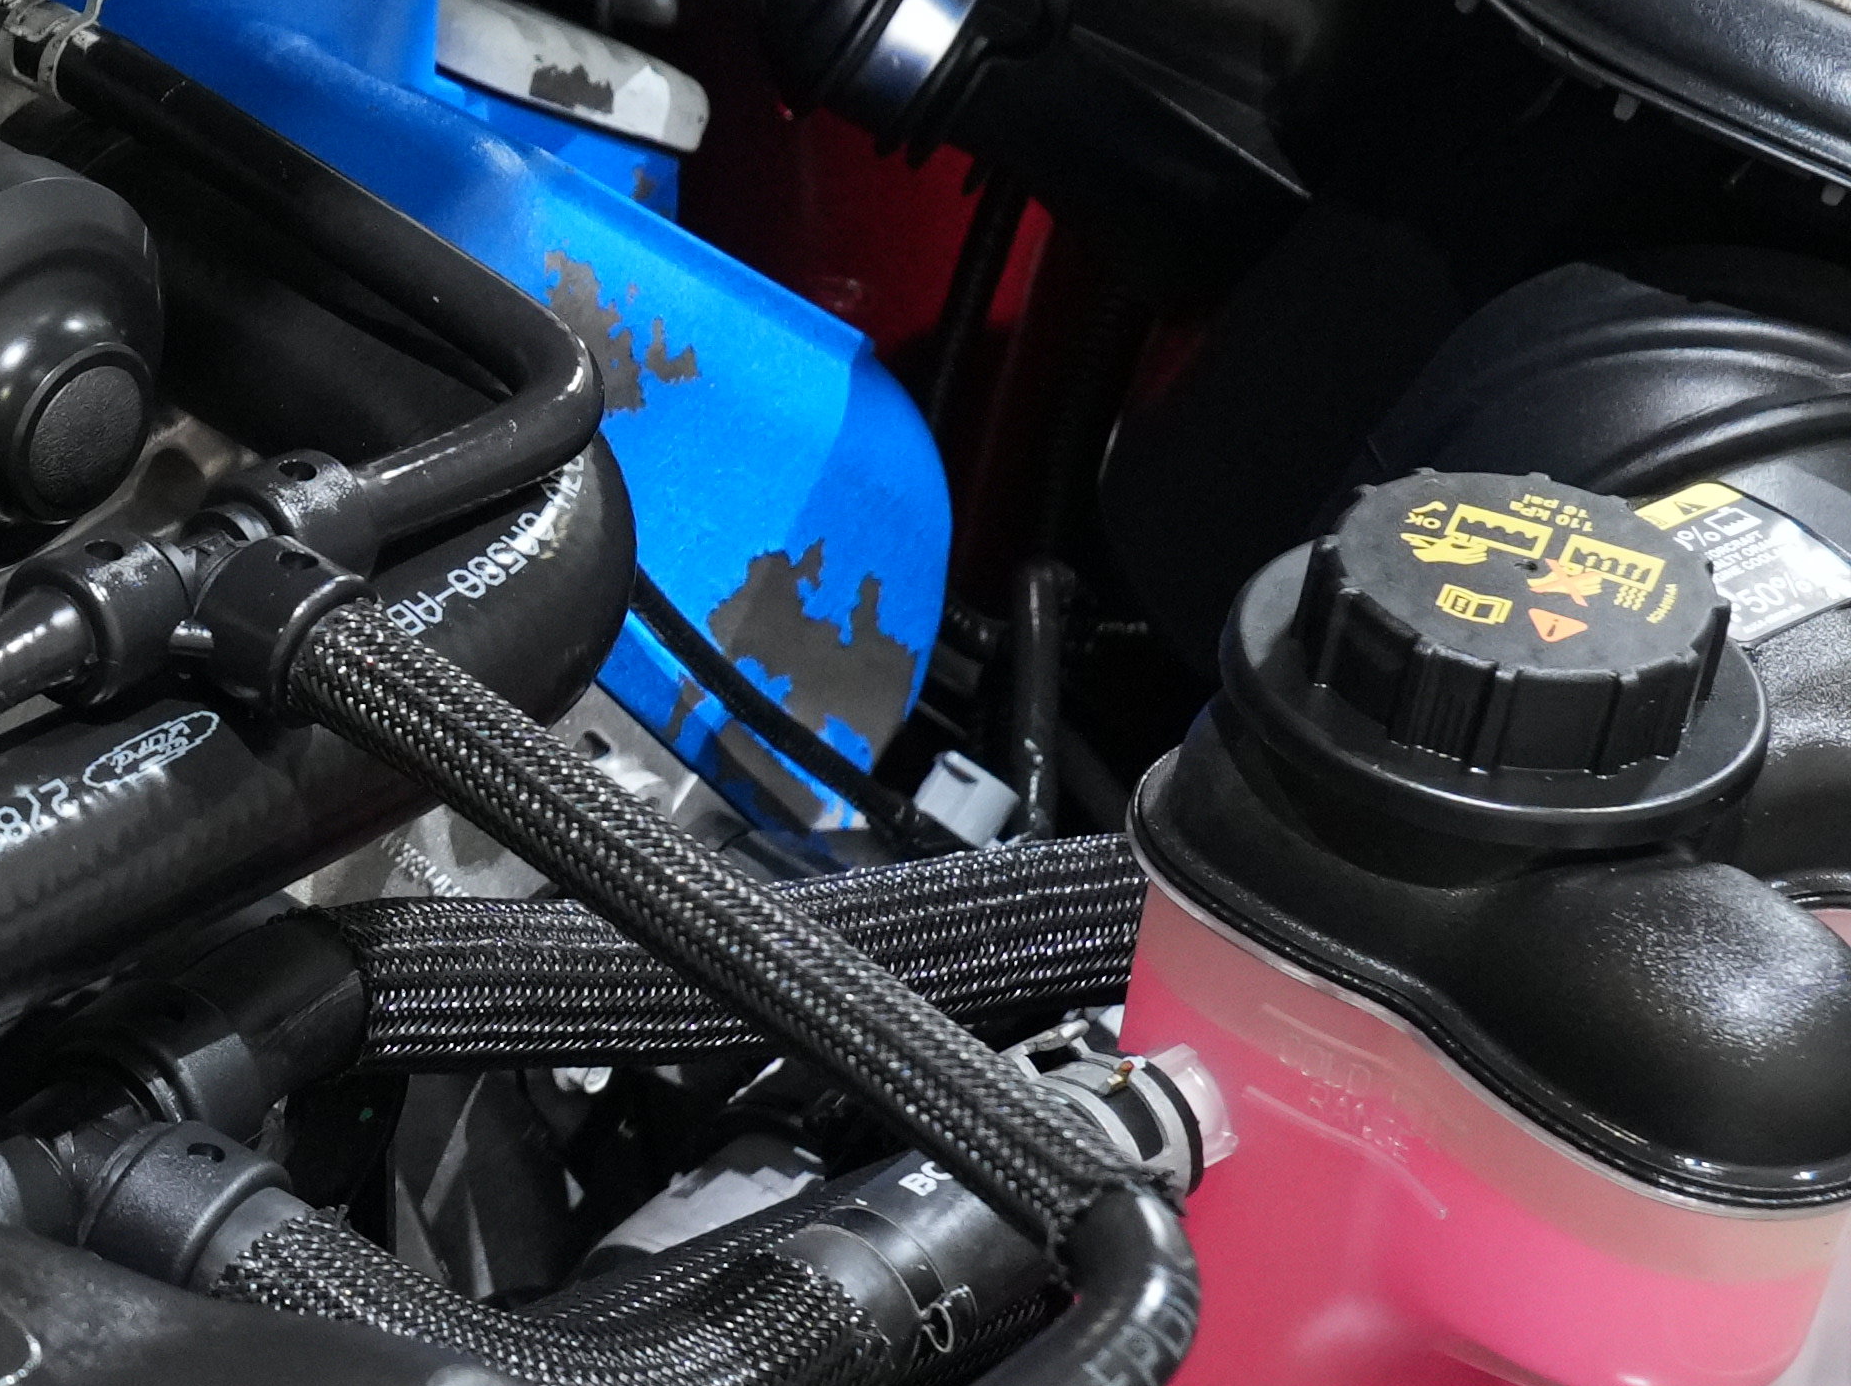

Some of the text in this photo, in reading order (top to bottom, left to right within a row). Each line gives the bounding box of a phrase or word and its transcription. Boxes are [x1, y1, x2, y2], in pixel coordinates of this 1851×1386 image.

[1404, 511, 1443, 530] OK
[1509, 500, 1593, 533] kPa 110
[99, 716, 206, 781] Ford
